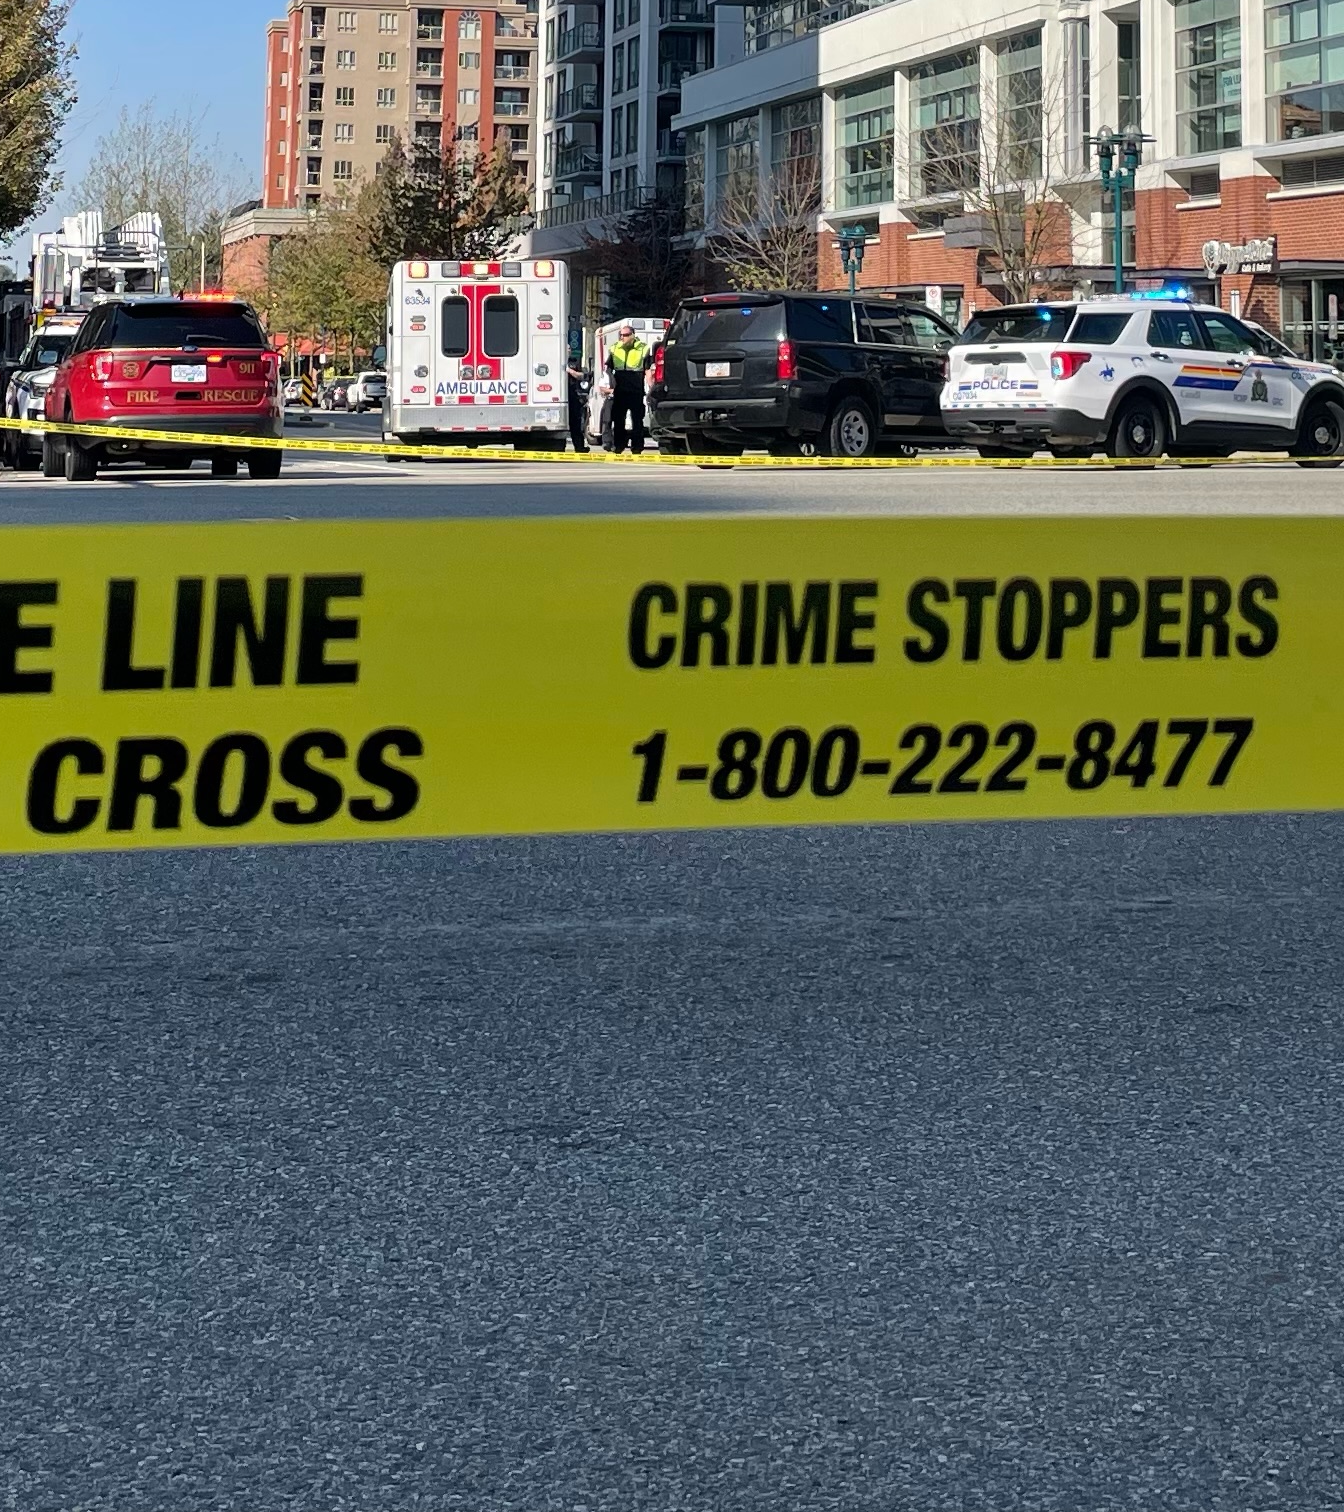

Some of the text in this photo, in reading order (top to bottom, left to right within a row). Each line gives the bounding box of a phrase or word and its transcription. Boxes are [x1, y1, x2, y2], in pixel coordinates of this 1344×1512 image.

[239, 362, 256, 375] 911
[436, 381, 528, 395] AMBULANCE
[972, 379, 1019, 390] POLICE
[126, 389, 260, 403] FIRE RESCUE
[100, 572, 366, 692] LINE
[627, 574, 1281, 671] CRIME STOPPERS
[25, 725, 426, 836] CROSS
[631, 717, 1256, 804] 1-800-222-8477
